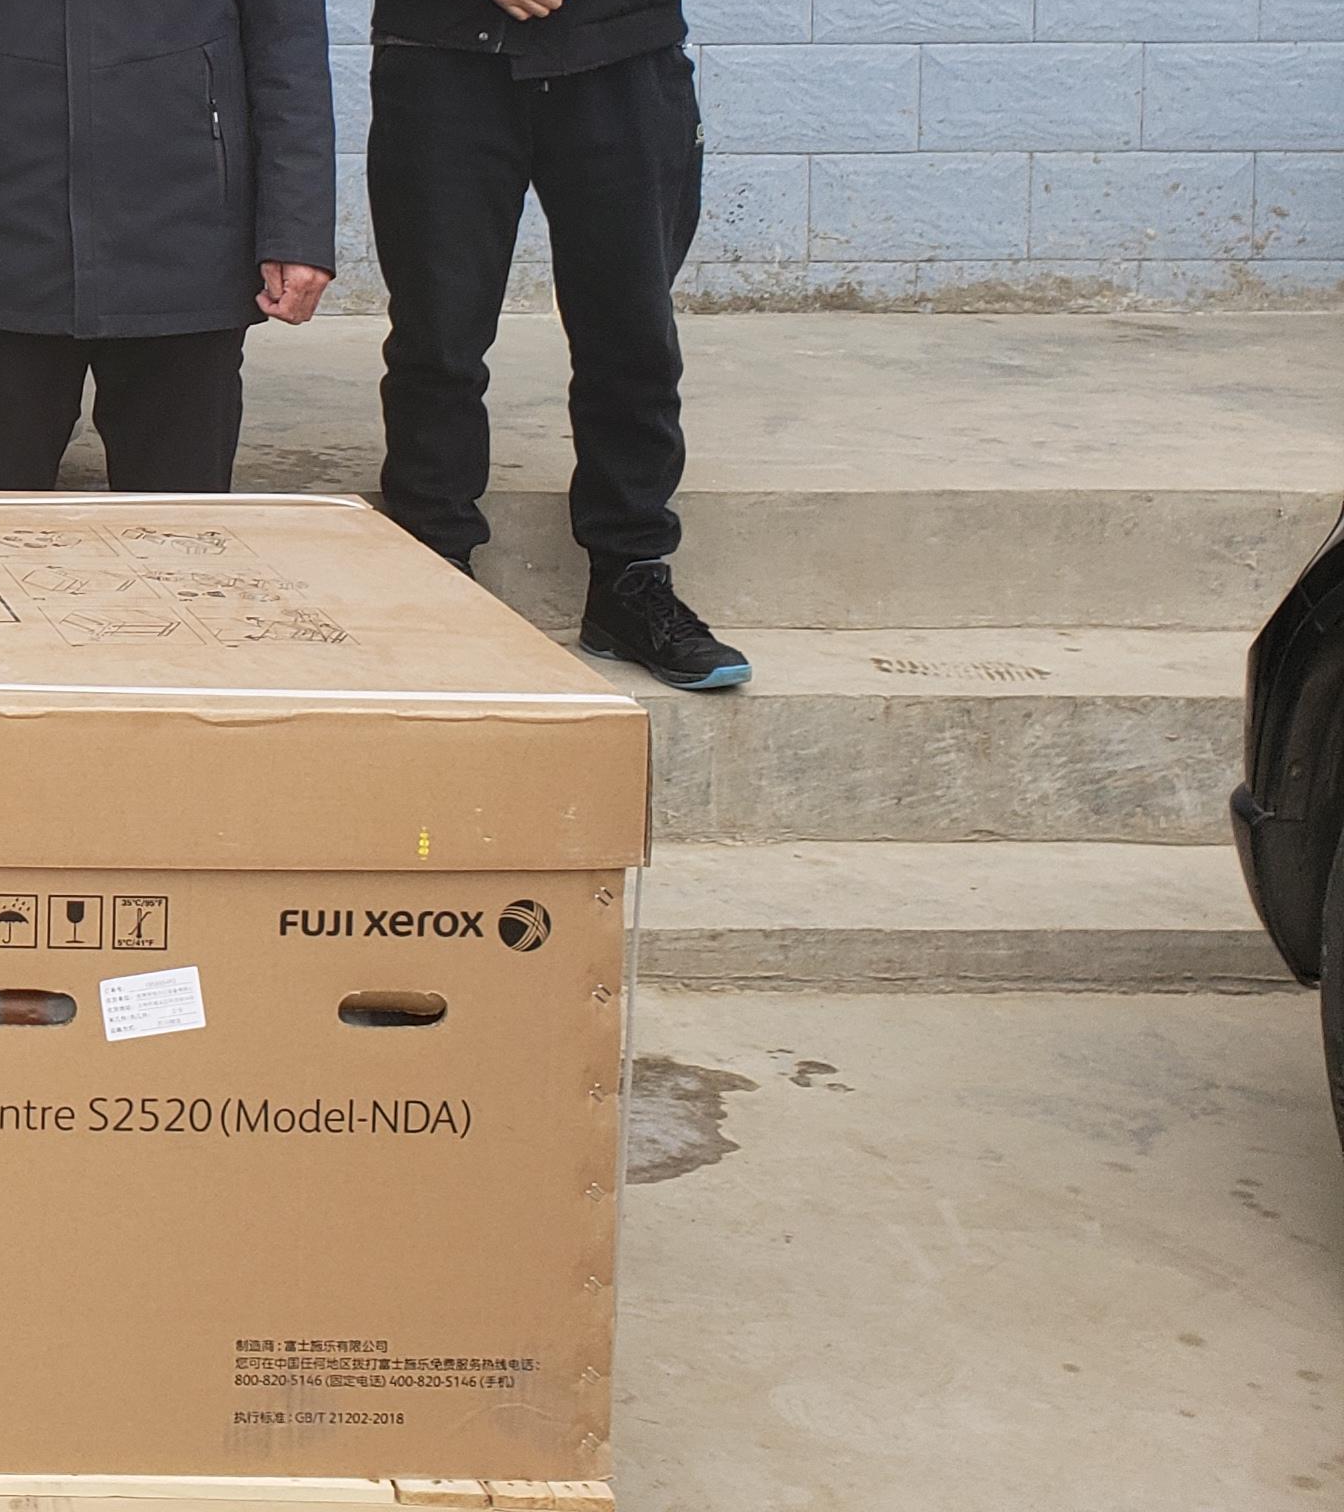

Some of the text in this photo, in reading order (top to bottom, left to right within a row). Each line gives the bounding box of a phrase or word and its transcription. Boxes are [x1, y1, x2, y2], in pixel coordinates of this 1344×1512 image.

[279, 909, 484, 938] FUJI xerox
[234, 1375, 323, 1387] 800-820-5146
[389, 1375, 478, 1388] 400-820-5146
[328, 1412, 405, 1426] 21202-2018
